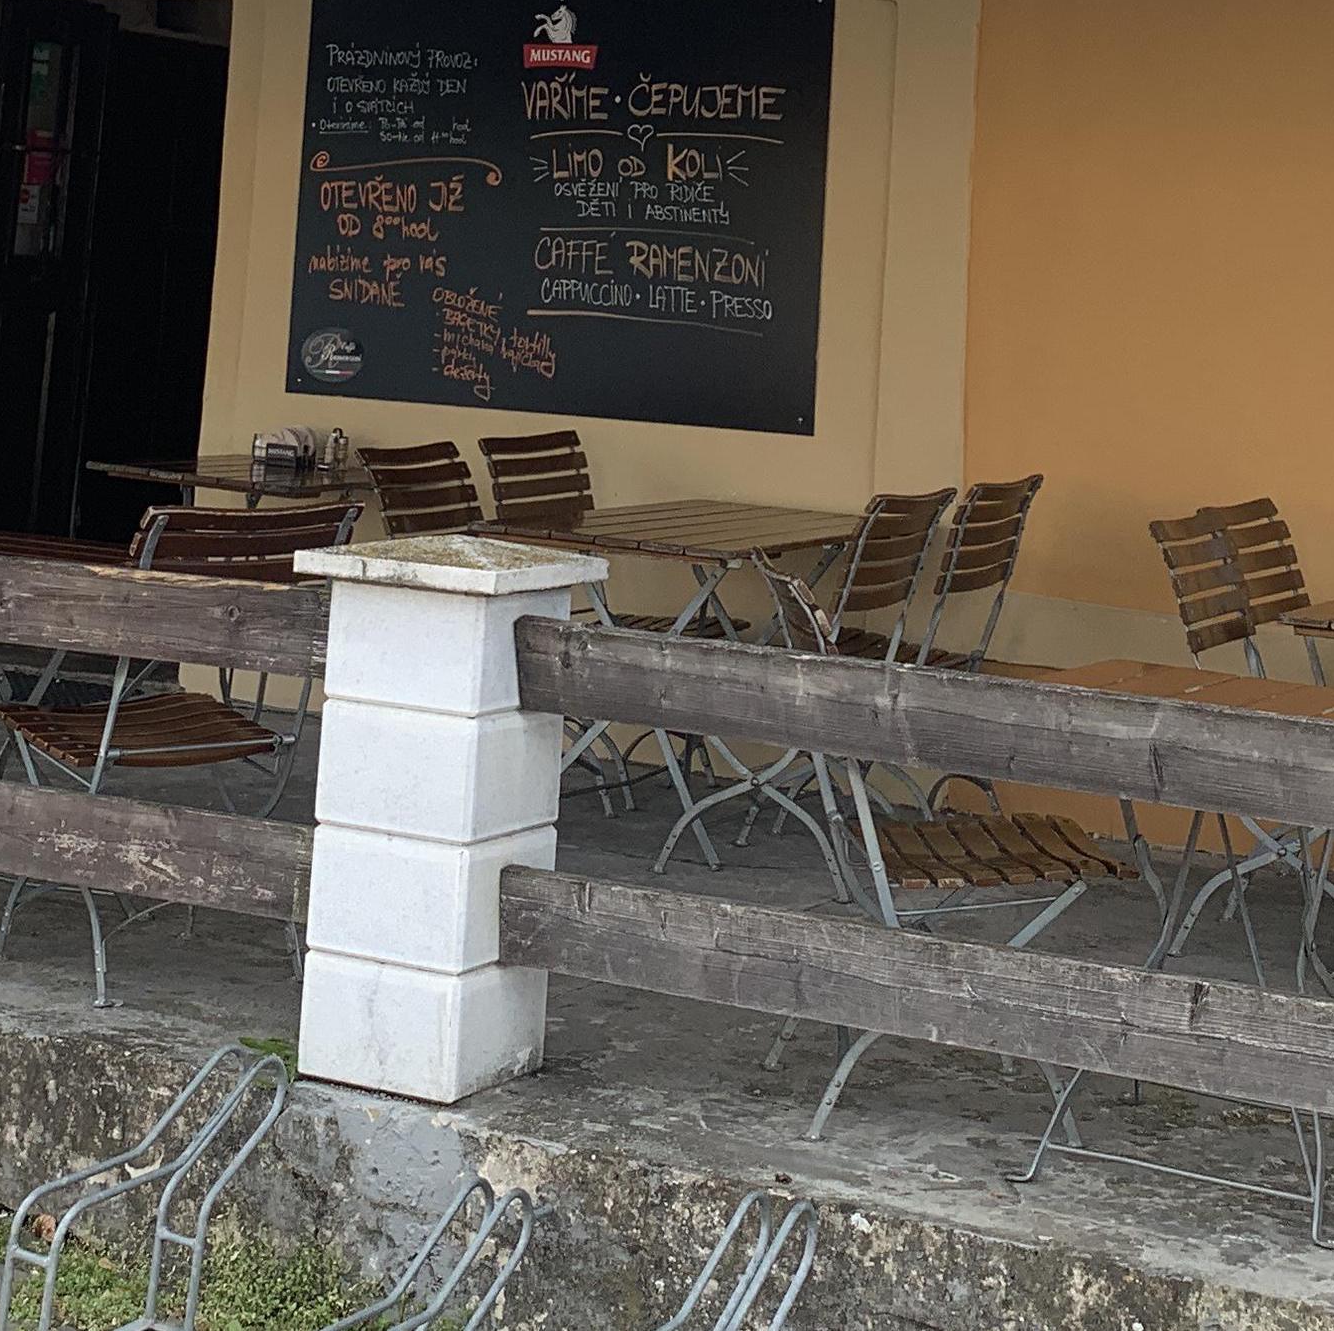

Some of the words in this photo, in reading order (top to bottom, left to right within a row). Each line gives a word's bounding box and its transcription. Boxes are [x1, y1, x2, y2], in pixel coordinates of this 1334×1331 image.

[326, 42, 420, 68] PRÁZDNINOVÝ
[529, 47, 592, 64] MUSTANG
[327, 75, 386, 93] OTEVŘENO
[393, 71, 430, 95] KAŽDÝ
[437, 79, 467, 96] DEN
[521, 71, 610, 120] VAŘÍME
[628, 71, 787, 121] ČEPUJEME
[618, 155, 647, 178] OD
[320, 174, 417, 214] OTEVŘENO
[630, 180, 659, 200] PRO
[336, 213, 361, 237] OD
[625, 240, 770, 291] RAMENZONI
[540, 276, 634, 308] CAPPUCCINO
[648, 284, 698, 314] LATTE
[709, 289, 773, 320] PRESSO
